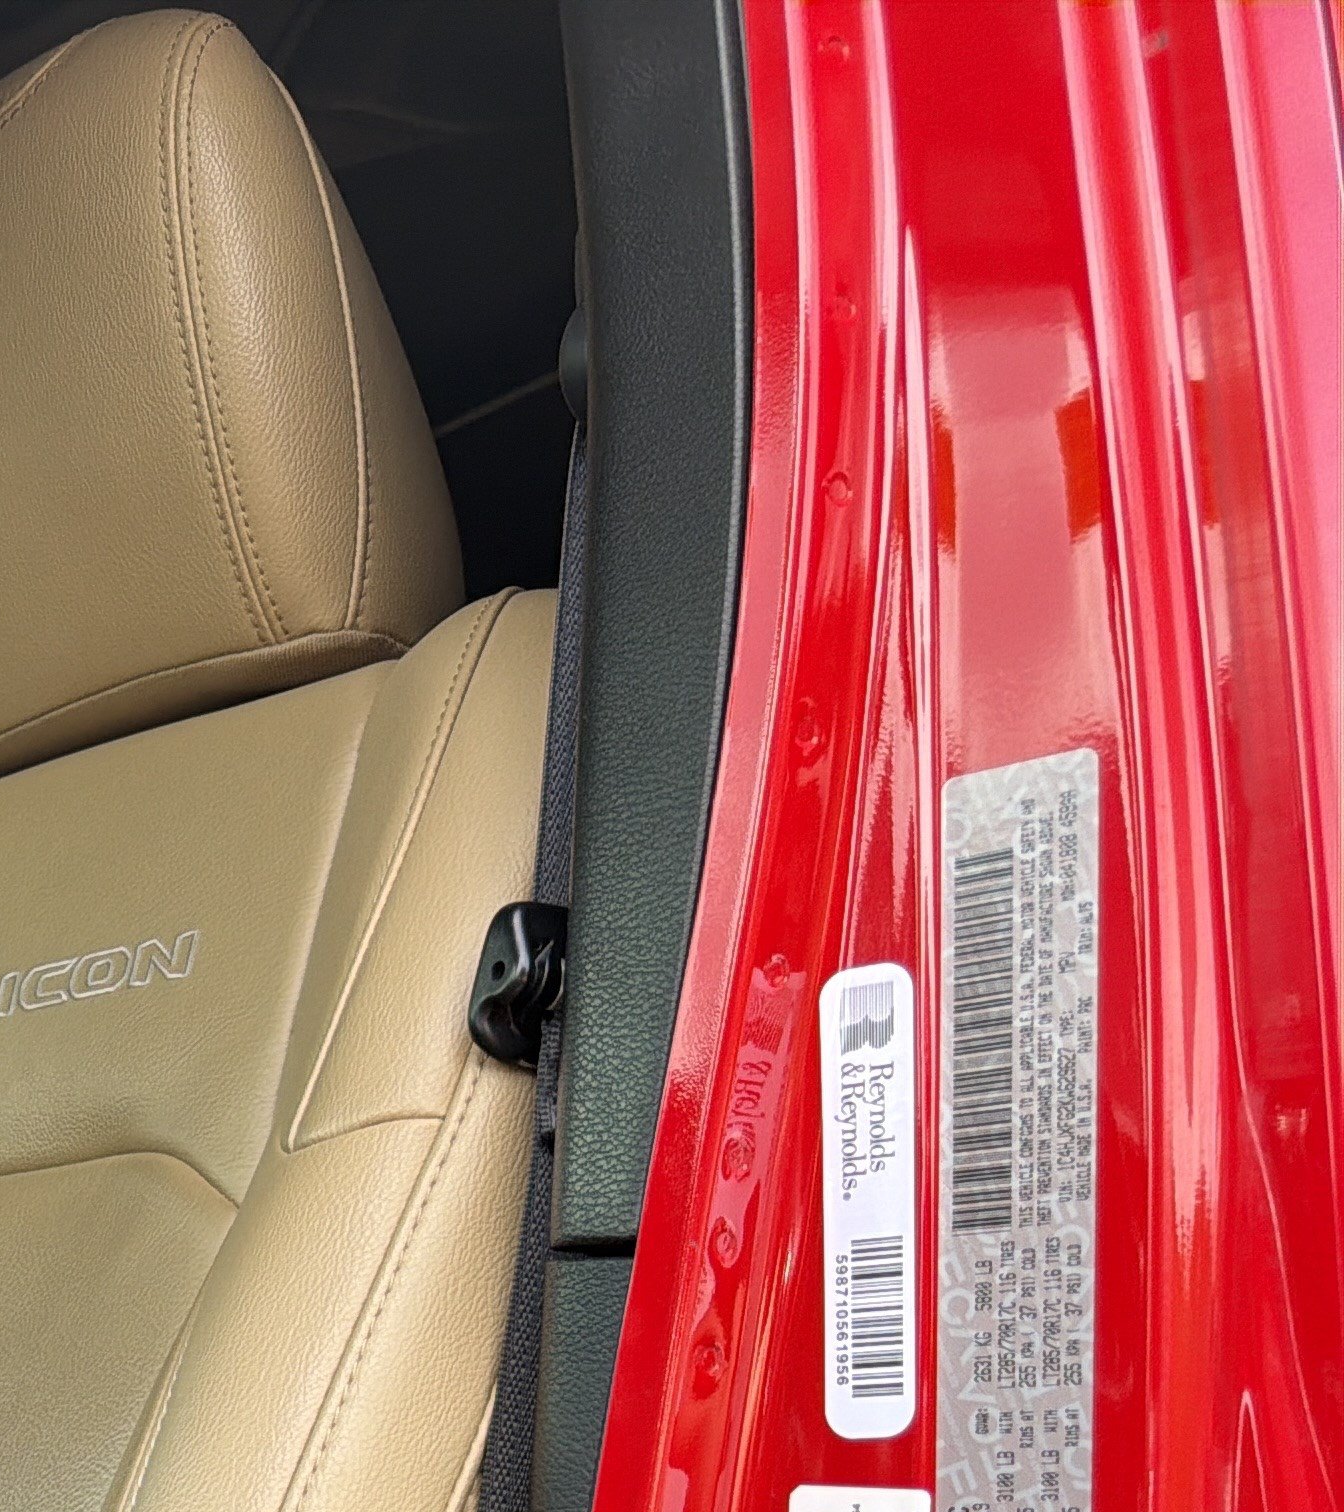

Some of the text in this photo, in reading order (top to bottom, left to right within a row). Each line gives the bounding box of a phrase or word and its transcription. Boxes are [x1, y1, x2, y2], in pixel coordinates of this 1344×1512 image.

[868, 1062, 895, 1173] Reynolds
[975, 1260, 992, 1275] LB
[998, 1273, 1016, 1294] 116
[1044, 1269, 1062, 1290] 116
[1019, 1306, 1037, 1320] 37
[1065, 1302, 1082, 1317] 37
[835, 1255, 849, 1386] 598710561956
[974, 1332, 992, 1346] KG
[974, 1355, 991, 1383] 2631
[1018, 1365, 1036, 1388] 255
[1064, 1363, 1082, 1386] 255
[997, 1451, 1014, 1466] LB
[1041, 1450, 1059, 1465] LB
